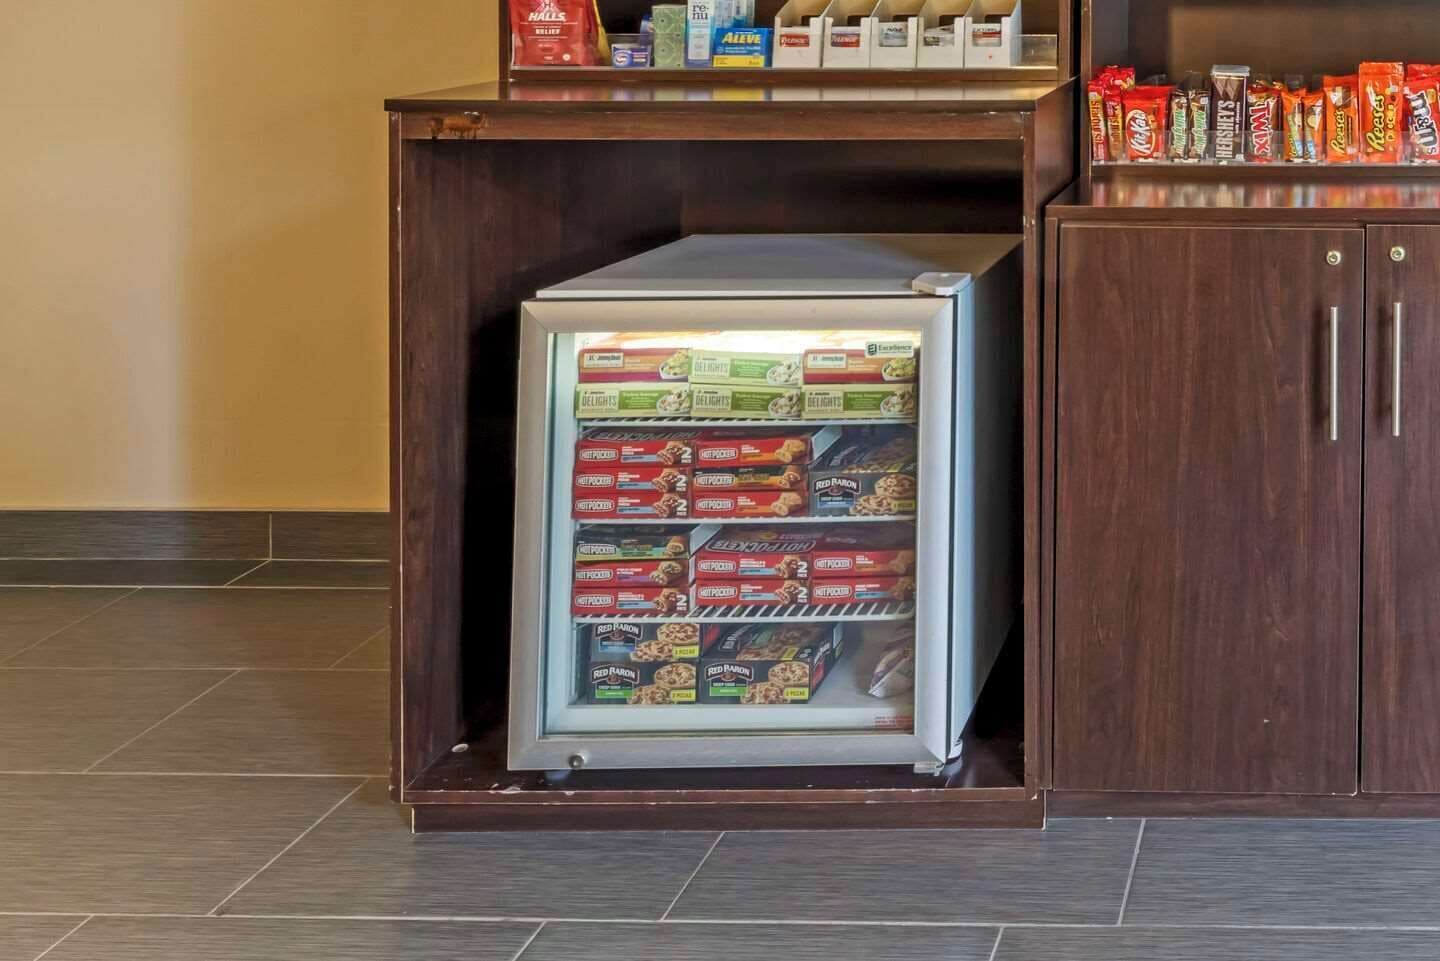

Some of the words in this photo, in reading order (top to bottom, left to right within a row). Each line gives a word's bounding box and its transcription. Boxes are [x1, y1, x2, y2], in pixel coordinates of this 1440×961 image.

[528, 12, 567, 21] HALLS
[722, 32, 761, 44] ALEVE
[1216, 100, 1235, 158] HERSHEY'S
[583, 395, 616, 407] DELIGHTS
[695, 395, 730, 407] DELIGHTS
[808, 396, 842, 408] DELIGHTS
[681, 447, 691, 459] 2
[676, 476, 687, 487] 2
[816, 480, 830, 490] RED
[831, 478, 857, 489] BARON
[676, 500, 687, 511] 2
[798, 562, 807, 571] 2
[798, 587, 807, 598] 2
[677, 595, 687, 605] 2
[594, 669, 608, 679] RED
[609, 667, 635, 678] BARON
[708, 667, 723, 676] RED
[724, 665, 750, 676] BARON
